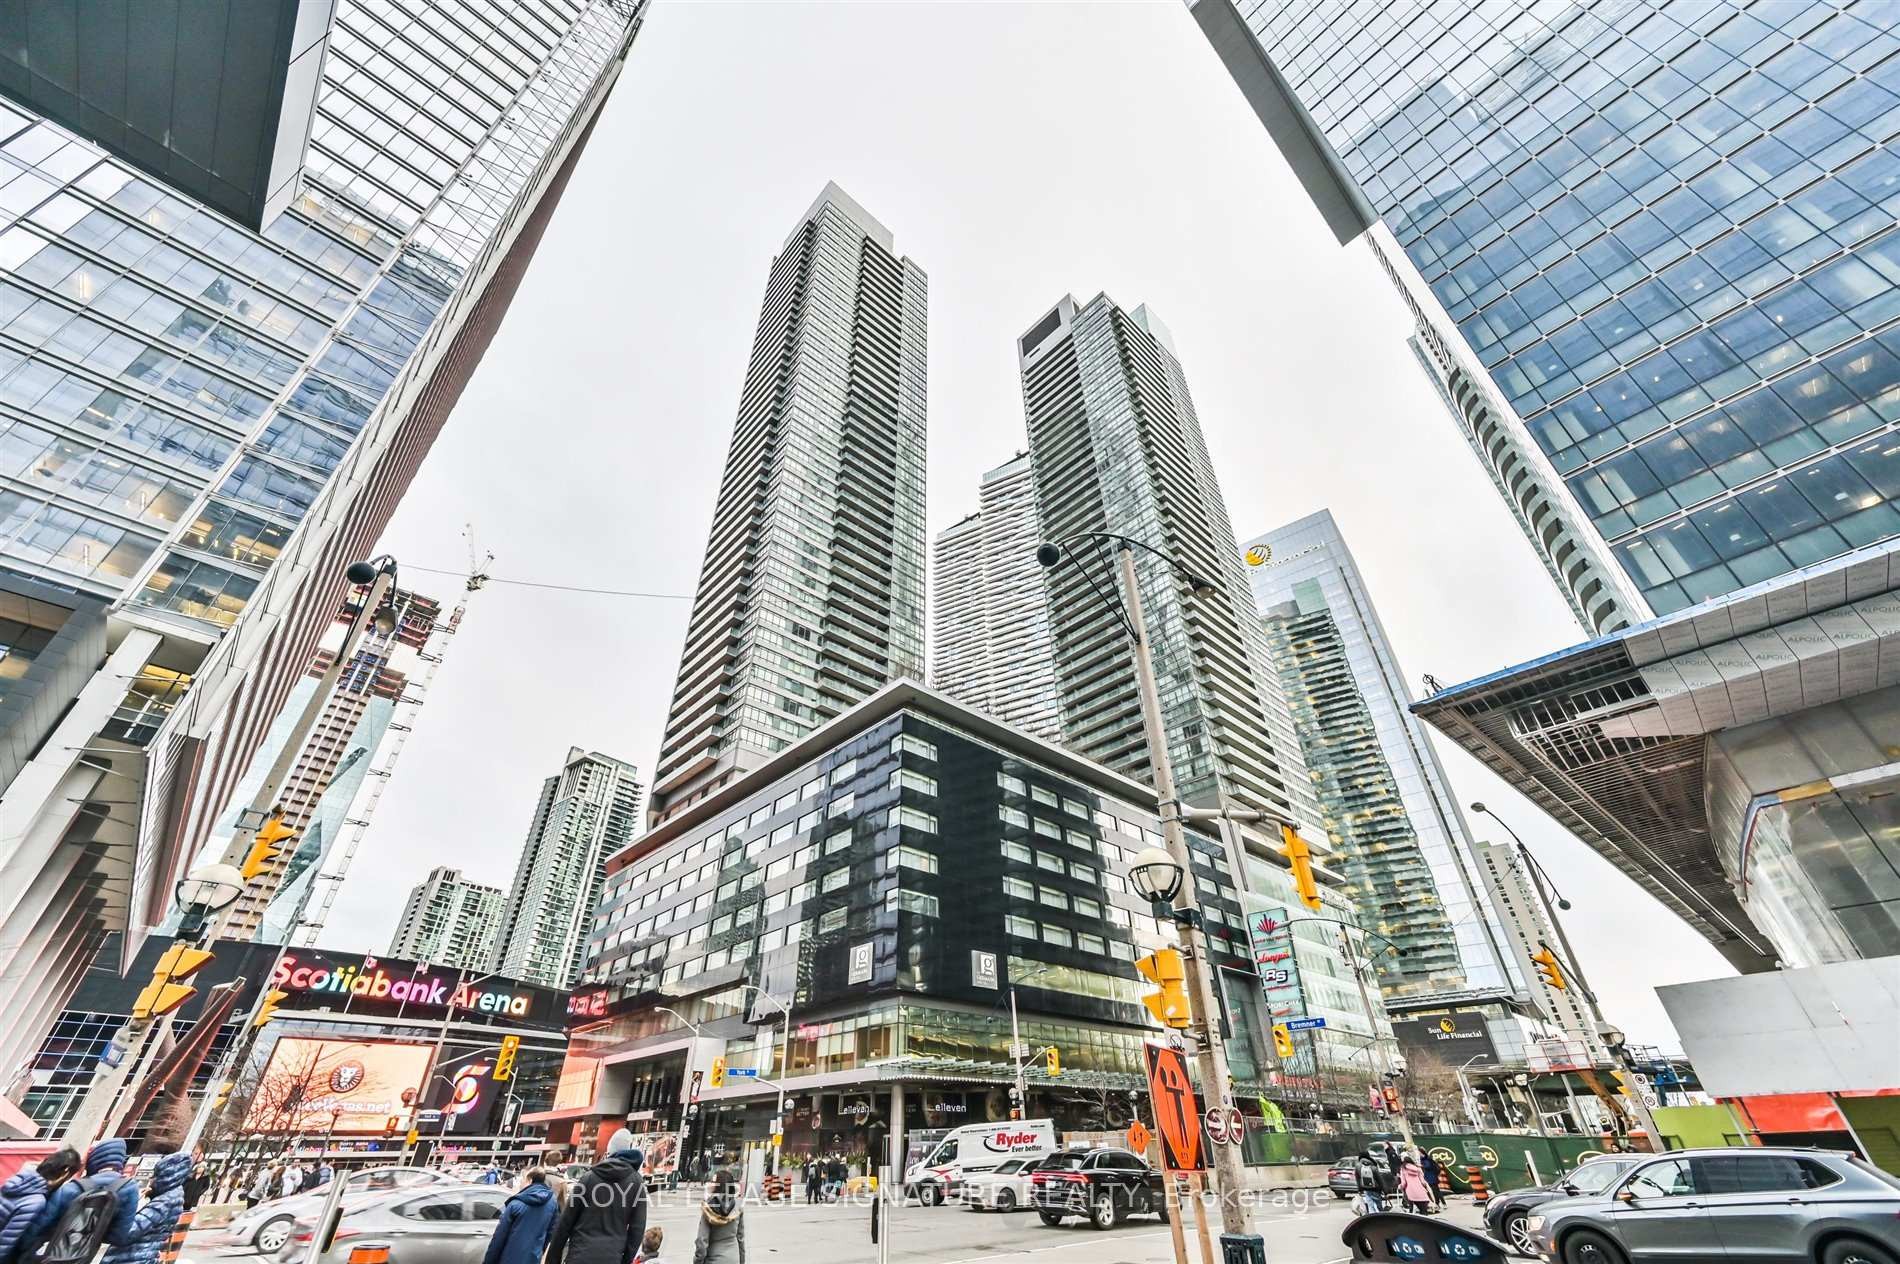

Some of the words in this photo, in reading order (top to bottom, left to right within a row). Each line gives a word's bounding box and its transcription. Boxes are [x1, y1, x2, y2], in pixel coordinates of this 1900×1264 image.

[1833, 632, 1874, 640] ALPOLIC
[271, 955, 448, 1005] Scotiabank
[447, 980, 528, 1015] Arena
[1290, 1020, 1316, 1030] Bremner
[1427, 1027, 1442, 1035] Sun
[1436, 1032, 1451, 1040] Life
[1451, 1030, 1483, 1039] Financial
[995, 1131, 1038, 1147] Ryder
[1011, 1145, 1025, 1153] Ever
[1024, 1144, 1043, 1152] better
[1431, 1151, 1452, 1161] PCL
